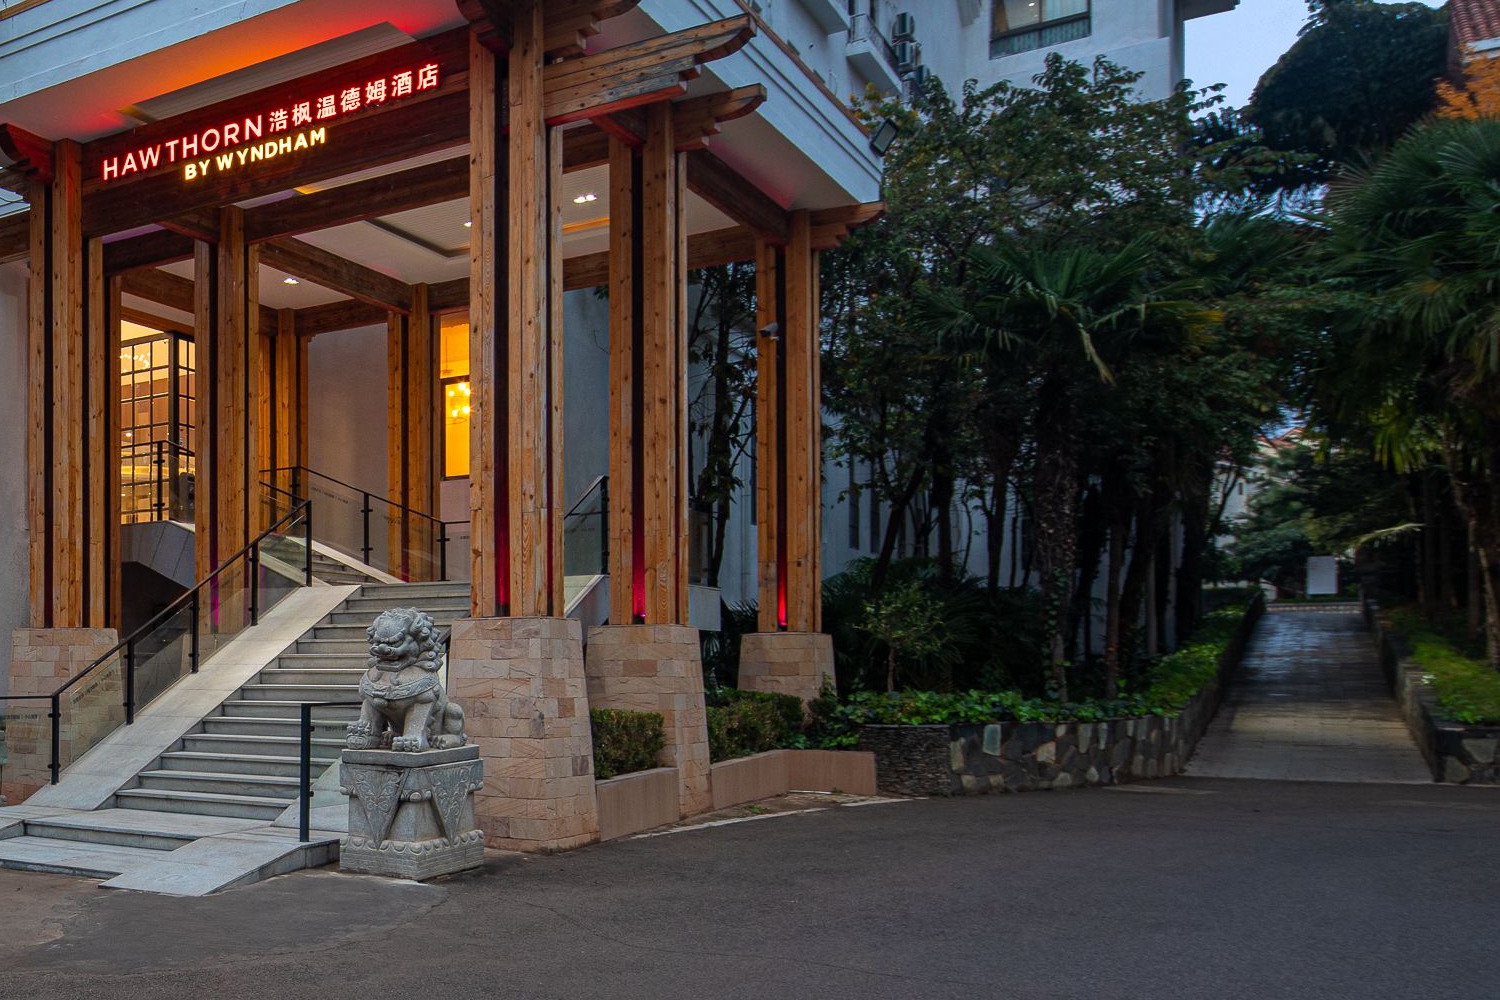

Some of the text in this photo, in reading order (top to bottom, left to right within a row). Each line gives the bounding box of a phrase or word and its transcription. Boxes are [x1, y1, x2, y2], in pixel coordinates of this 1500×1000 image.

[103, 63, 439, 181] HAWTHORN 浩枫温德姆酒店
[184, 127, 326, 181] BY WYNDHAM
